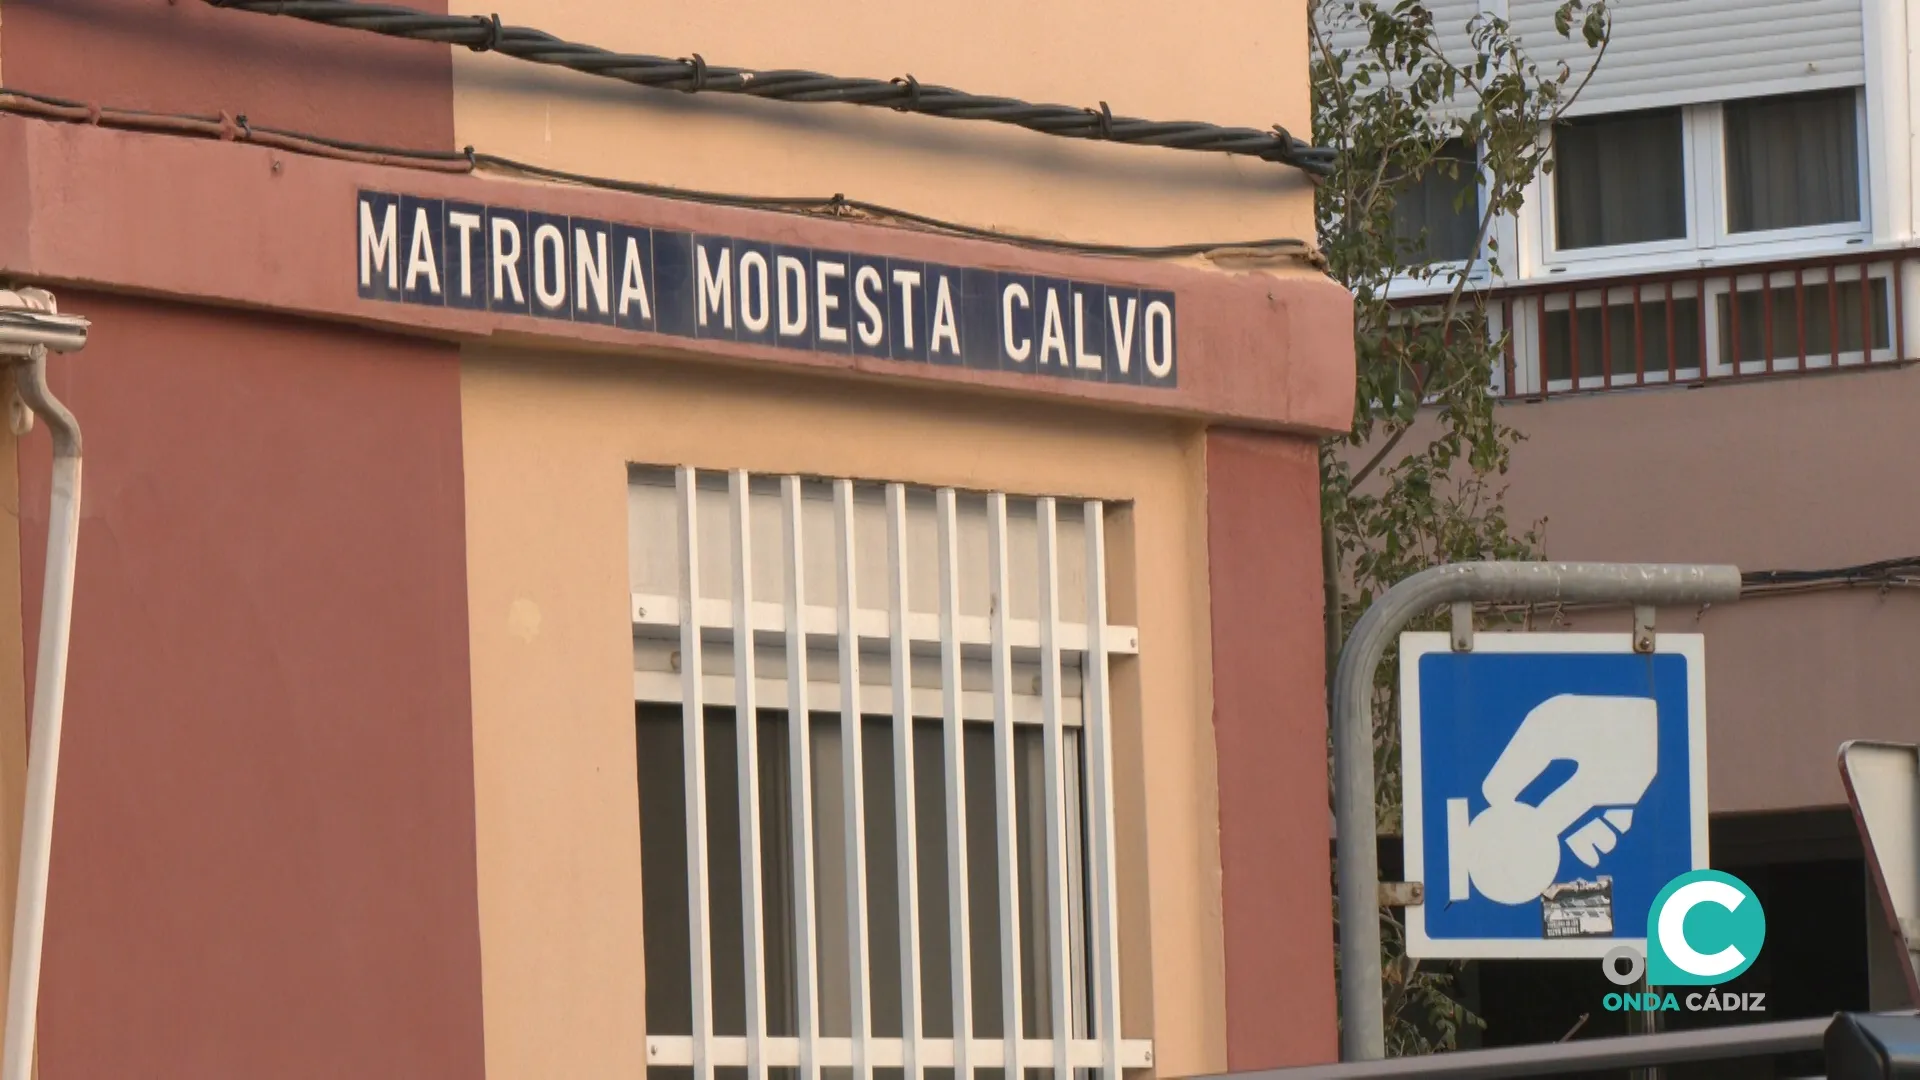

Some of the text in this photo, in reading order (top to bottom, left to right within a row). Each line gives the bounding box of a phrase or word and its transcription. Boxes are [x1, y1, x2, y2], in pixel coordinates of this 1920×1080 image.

[358, 201, 1173, 378] MATRONA MODESTA CALVO
